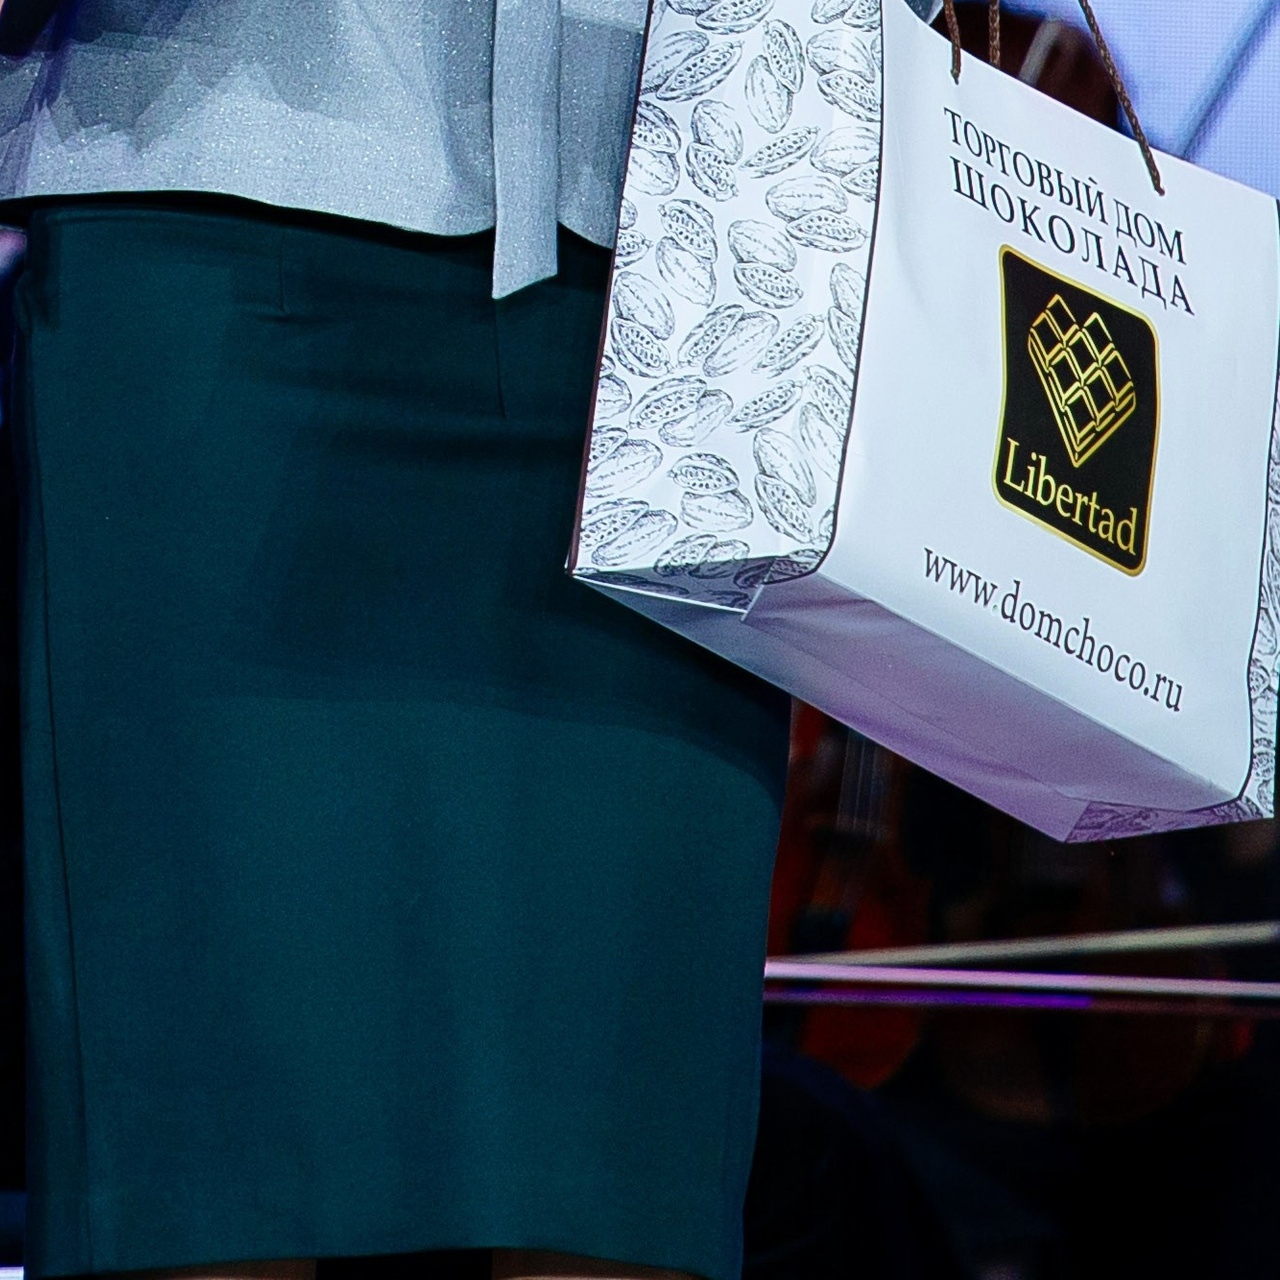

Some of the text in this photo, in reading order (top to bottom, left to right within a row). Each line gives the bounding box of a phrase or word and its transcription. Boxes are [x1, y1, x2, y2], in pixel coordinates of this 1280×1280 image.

[943, 106, 1187, 266] ТОРГОВЫЙ ДОМ
[949, 155, 1195, 316] ШОКОЛАДА
[1003, 437, 1138, 556] Libertad
[923, 546, 1183, 712] www.domchoco.ru
